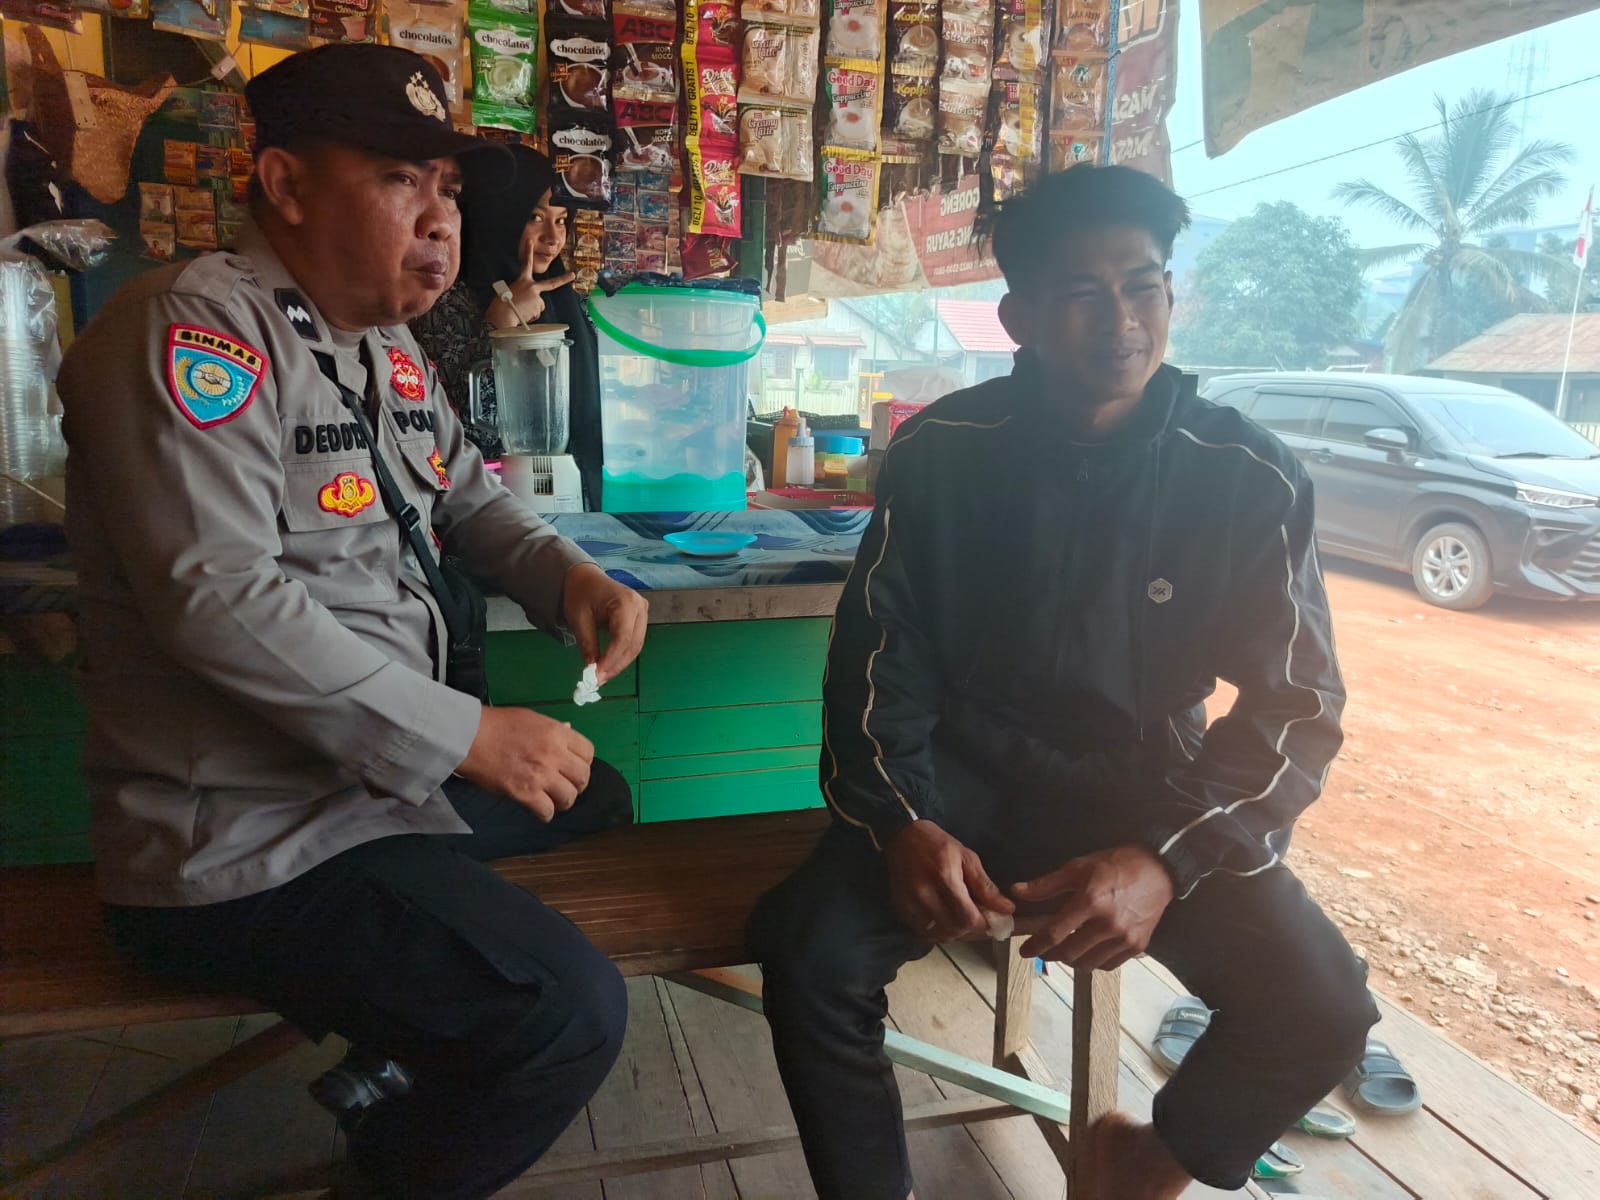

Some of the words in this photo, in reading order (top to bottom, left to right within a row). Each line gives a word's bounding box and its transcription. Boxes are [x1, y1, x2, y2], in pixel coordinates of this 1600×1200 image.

[686, 13, 695, 24] 10
[621, 18, 672, 40] ABC
[686, 28, 695, 45] BELI
[686, 68, 696, 100] GRATIS
[828, 71, 855, 86] Good
[856, 74, 876, 90] Day
[621, 103, 672, 121] ABC
[689, 105, 698, 114] 10
[689, 115, 698, 136] BELI
[824, 160, 852, 175] Good
[853, 164, 873, 178] Day
[827, 179, 867, 192] Cappuccino
[693, 196, 702, 206] 10
[692, 207, 702, 226] BELI
[181, 330, 257, 366] BINMAS
